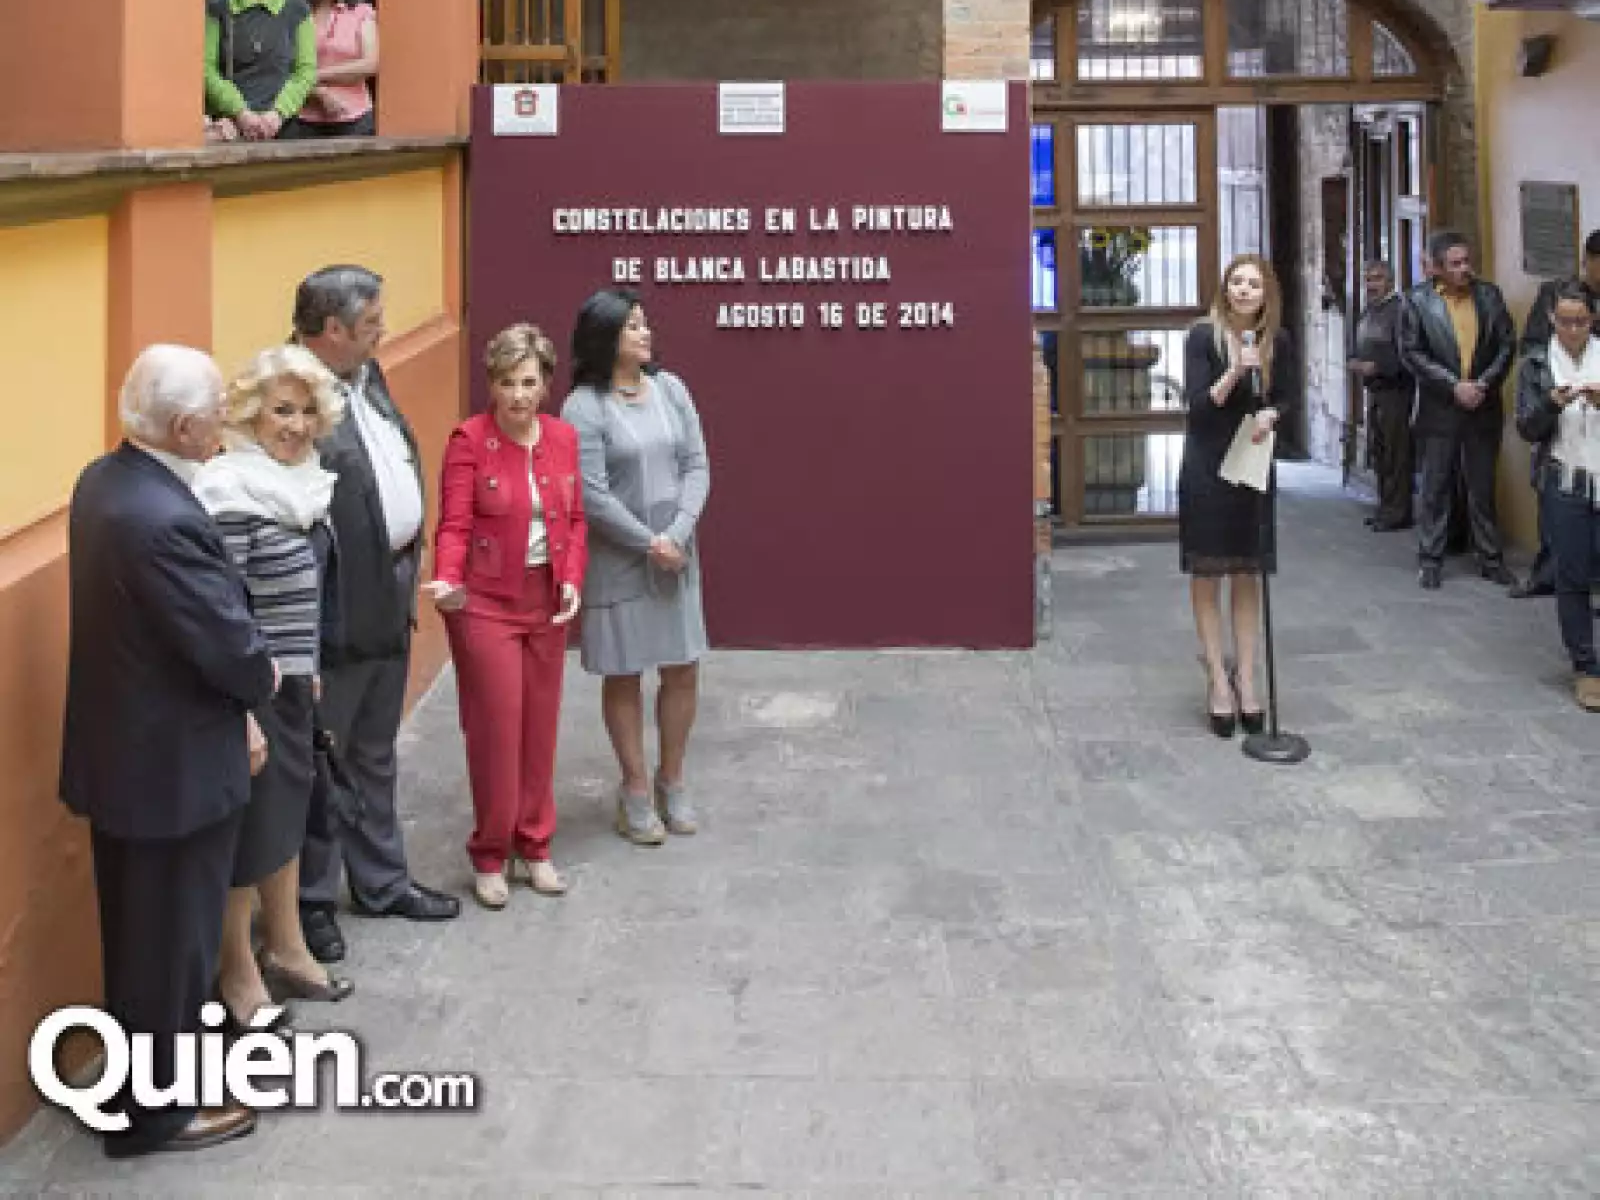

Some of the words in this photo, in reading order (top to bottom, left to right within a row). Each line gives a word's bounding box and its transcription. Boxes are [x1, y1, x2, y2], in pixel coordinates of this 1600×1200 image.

[551, 207, 750, 232] CONSTELACIONES
[763, 208, 796, 232] EN
[809, 207, 840, 231] LA
[851, 206, 954, 231] PINTURA
[612, 257, 642, 282] DE
[655, 256, 746, 281] BLANCA
[760, 256, 892, 281] LABASTIDA
[716, 303, 805, 328] AGOSTO
[818, 303, 843, 327] 16
[857, 303, 887, 327] DE
[899, 302, 955, 327] 2014
